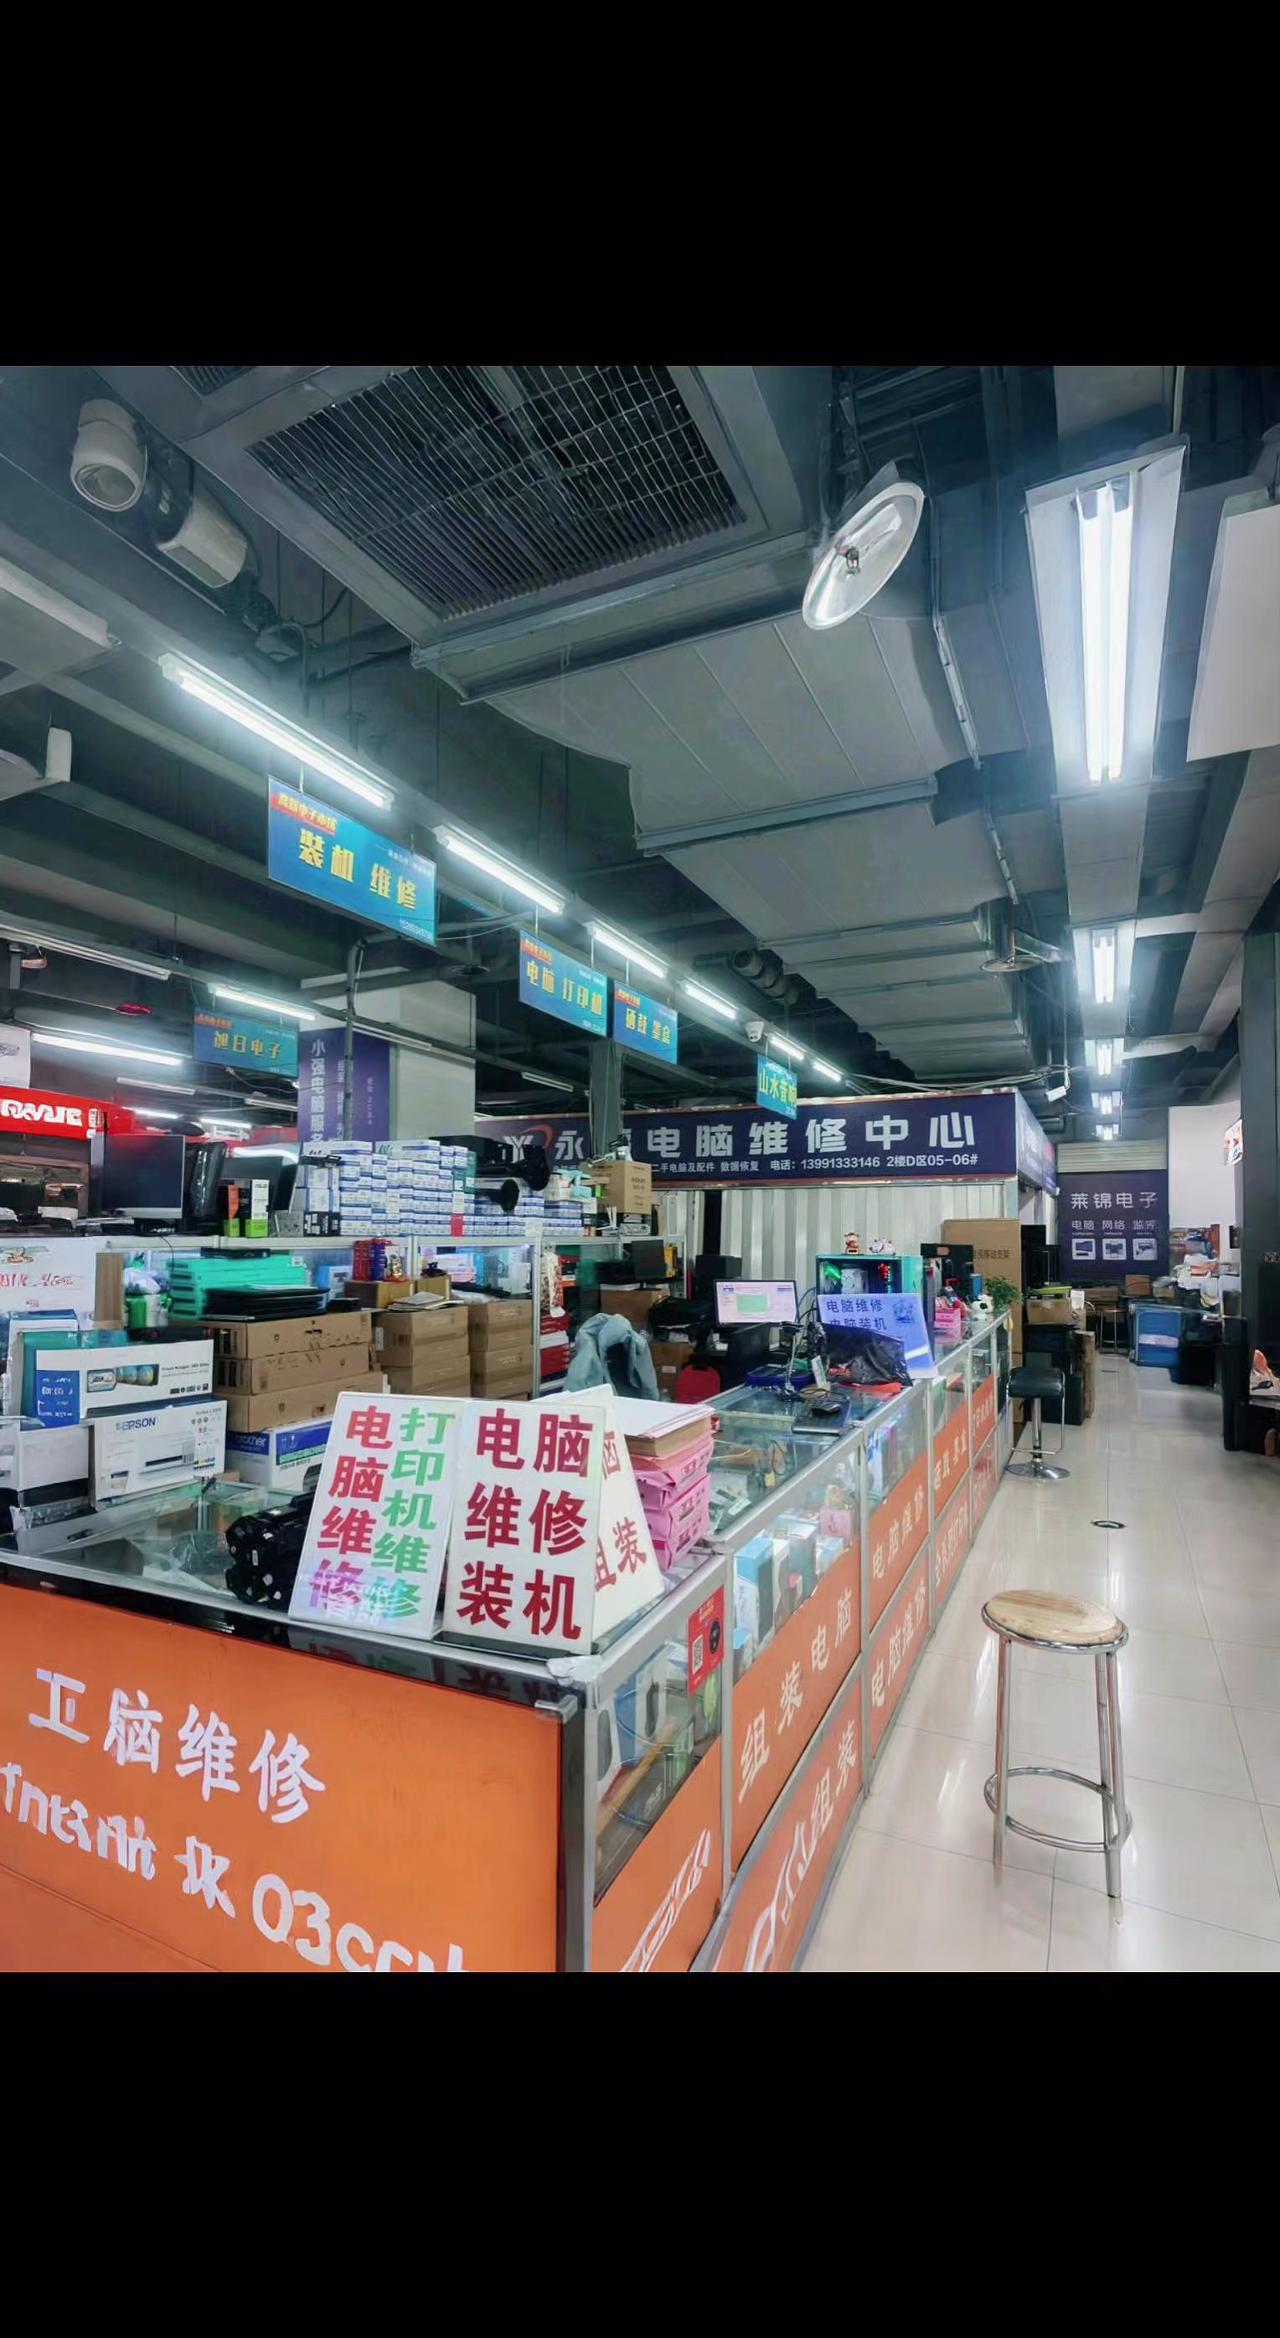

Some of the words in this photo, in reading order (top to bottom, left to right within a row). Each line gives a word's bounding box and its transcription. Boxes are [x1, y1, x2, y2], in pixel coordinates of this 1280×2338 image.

[298, 827, 355, 884] 装机
[369, 862, 417, 911] 维修
[554, 1111, 976, 1162] 永电脑维修中心
[1070, 1191, 1157, 1210] 莱锦电子
[1071, 1220, 1094, 1231] 电脑
[1102, 1220, 1126, 1231] 网络
[826, 1299, 884, 1313] 电脑维修
[475, 1407, 594, 1478] 电脑
[463, 1481, 589, 1556] 维修
[456, 1561, 582, 1640] 装机
